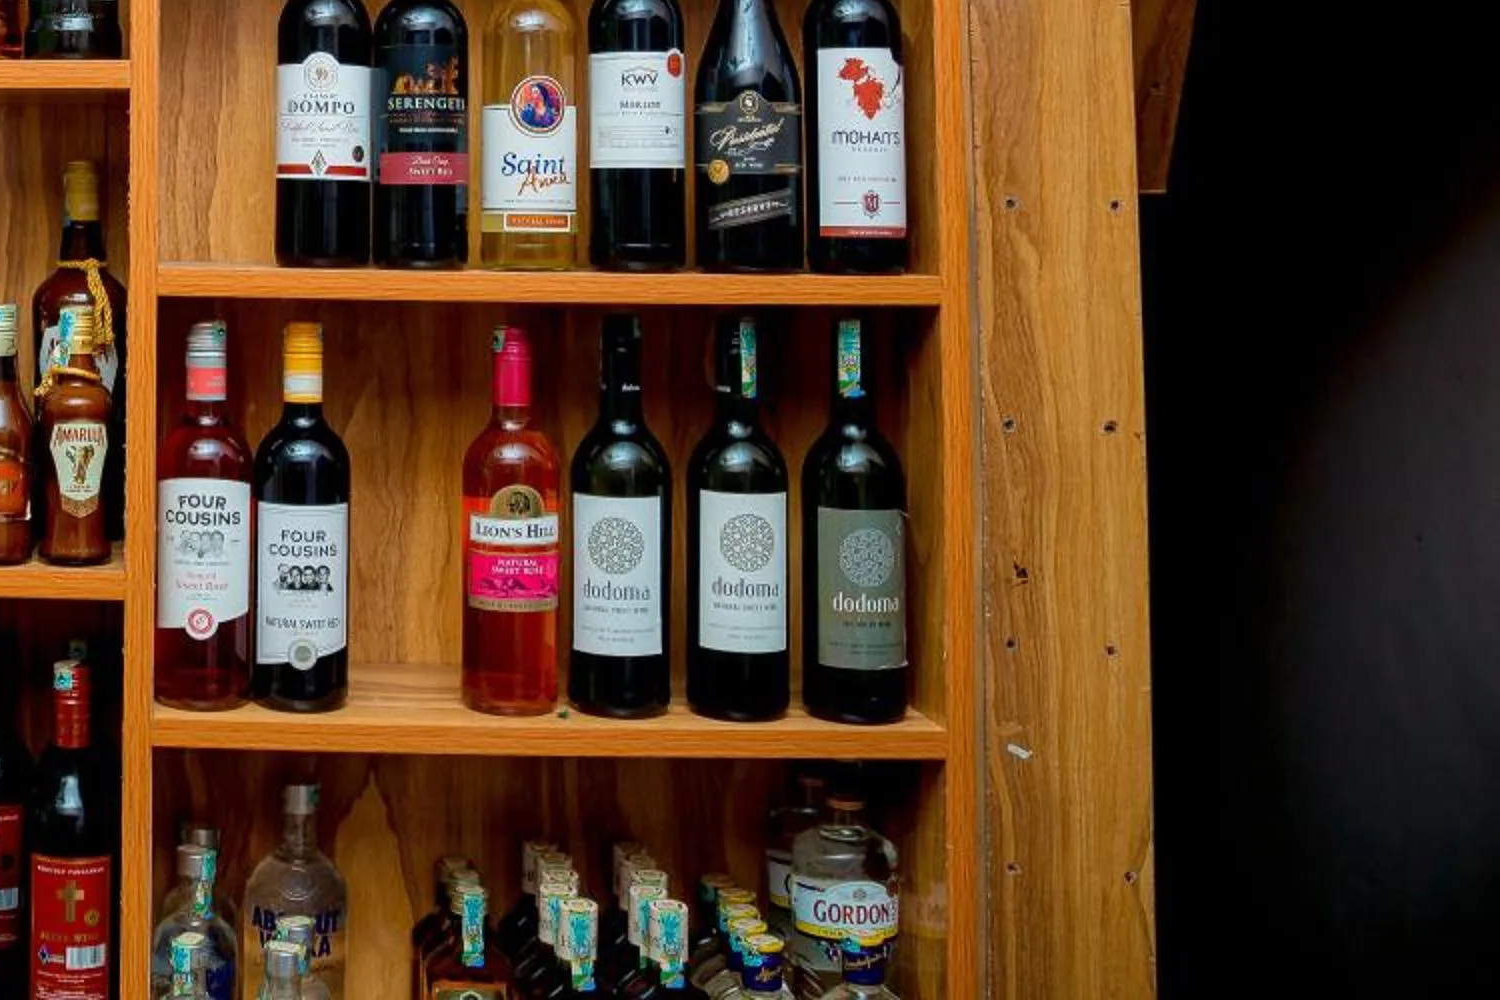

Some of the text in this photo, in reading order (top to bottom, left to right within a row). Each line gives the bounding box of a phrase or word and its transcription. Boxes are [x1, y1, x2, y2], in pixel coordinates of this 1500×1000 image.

[620, 73, 659, 86] KWV
[287, 100, 356, 115] DOMPO
[501, 151, 566, 177] Saint
[52, 424, 106, 447] AMARULA
[177, 494, 227, 511] FOUR
[165, 509, 241, 526] COUSINS
[280, 529, 327, 543] FOUR
[474, 521, 524, 538] LION'S
[268, 543, 338, 559] COUSINS
[582, 577, 651, 601] dodoma
[711, 575, 780, 599] dodoma
[831, 590, 900, 614] dodoma
